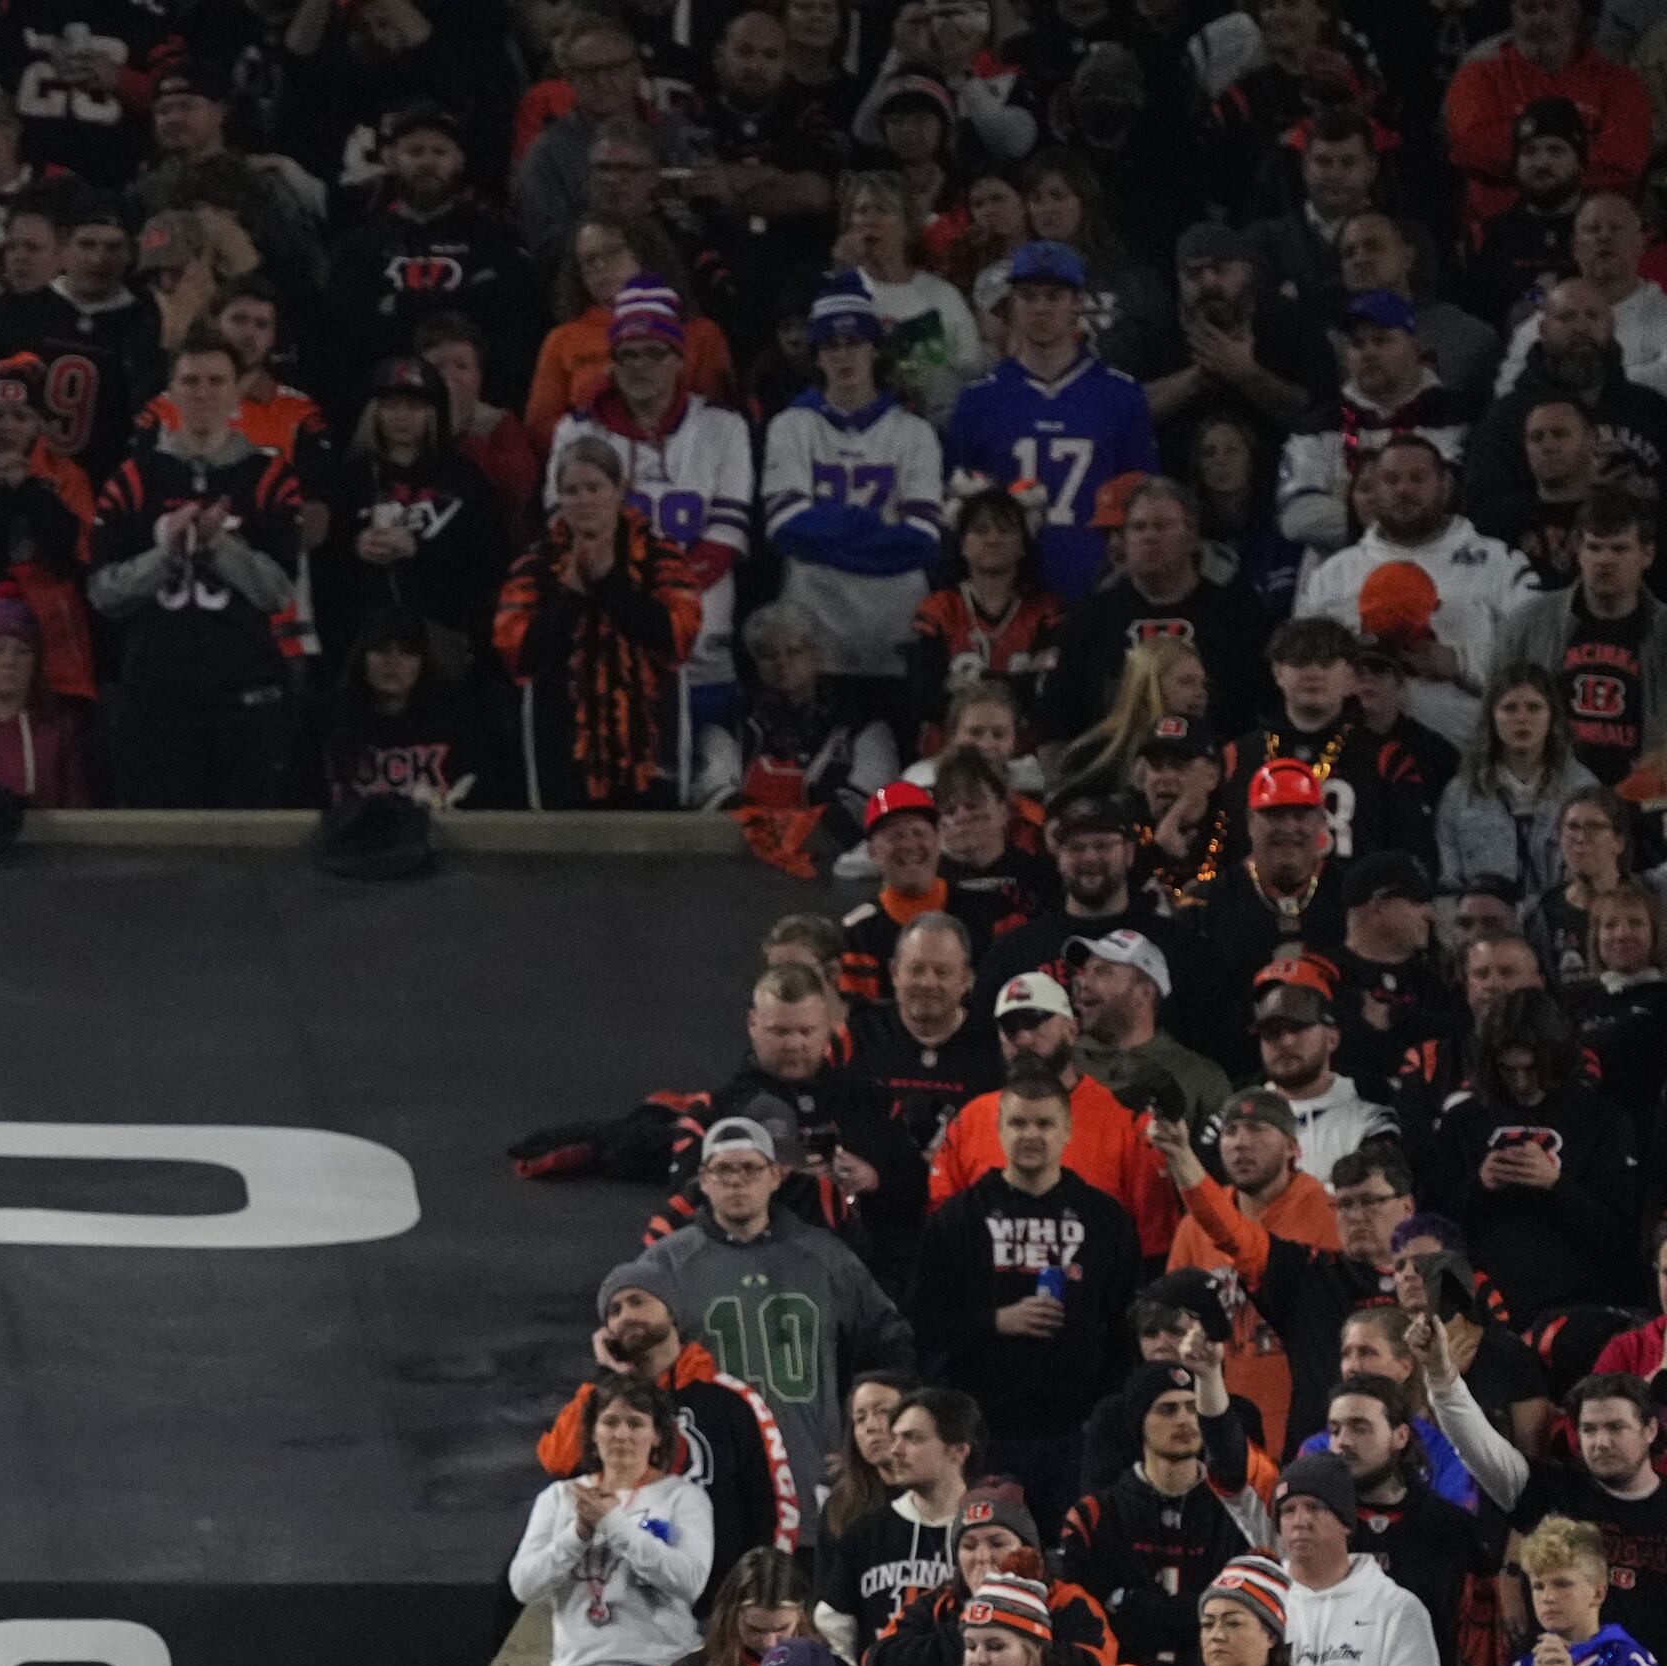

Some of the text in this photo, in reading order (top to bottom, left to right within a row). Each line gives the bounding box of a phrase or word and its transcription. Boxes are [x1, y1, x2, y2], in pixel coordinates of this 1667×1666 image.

[44, 353, 98, 456] 9
[1012, 436, 1094, 526] 17
[985, 1215, 1085, 1242] WHO
[991, 1241, 1082, 1273] DEY
[706, 1294, 819, 1403] 10
